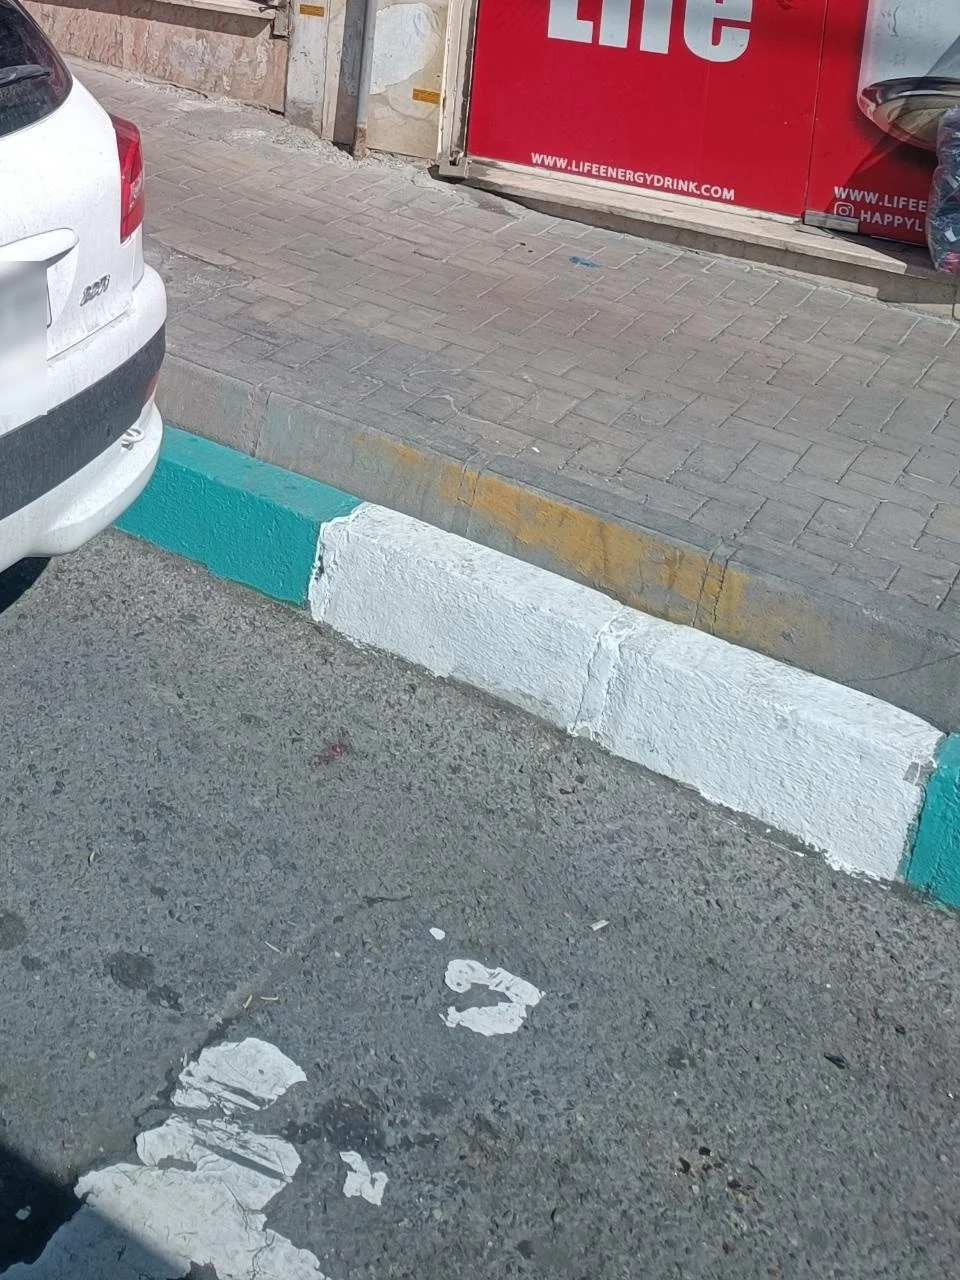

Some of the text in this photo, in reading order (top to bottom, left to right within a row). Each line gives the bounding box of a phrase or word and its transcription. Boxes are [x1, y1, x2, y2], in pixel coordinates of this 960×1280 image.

[531, 152, 736, 201] WWW.LIFEENERGYDRINK.COM
[833, 185, 928, 213] WWW.LIFEE
[860, 209, 923, 232] HAPPYL
